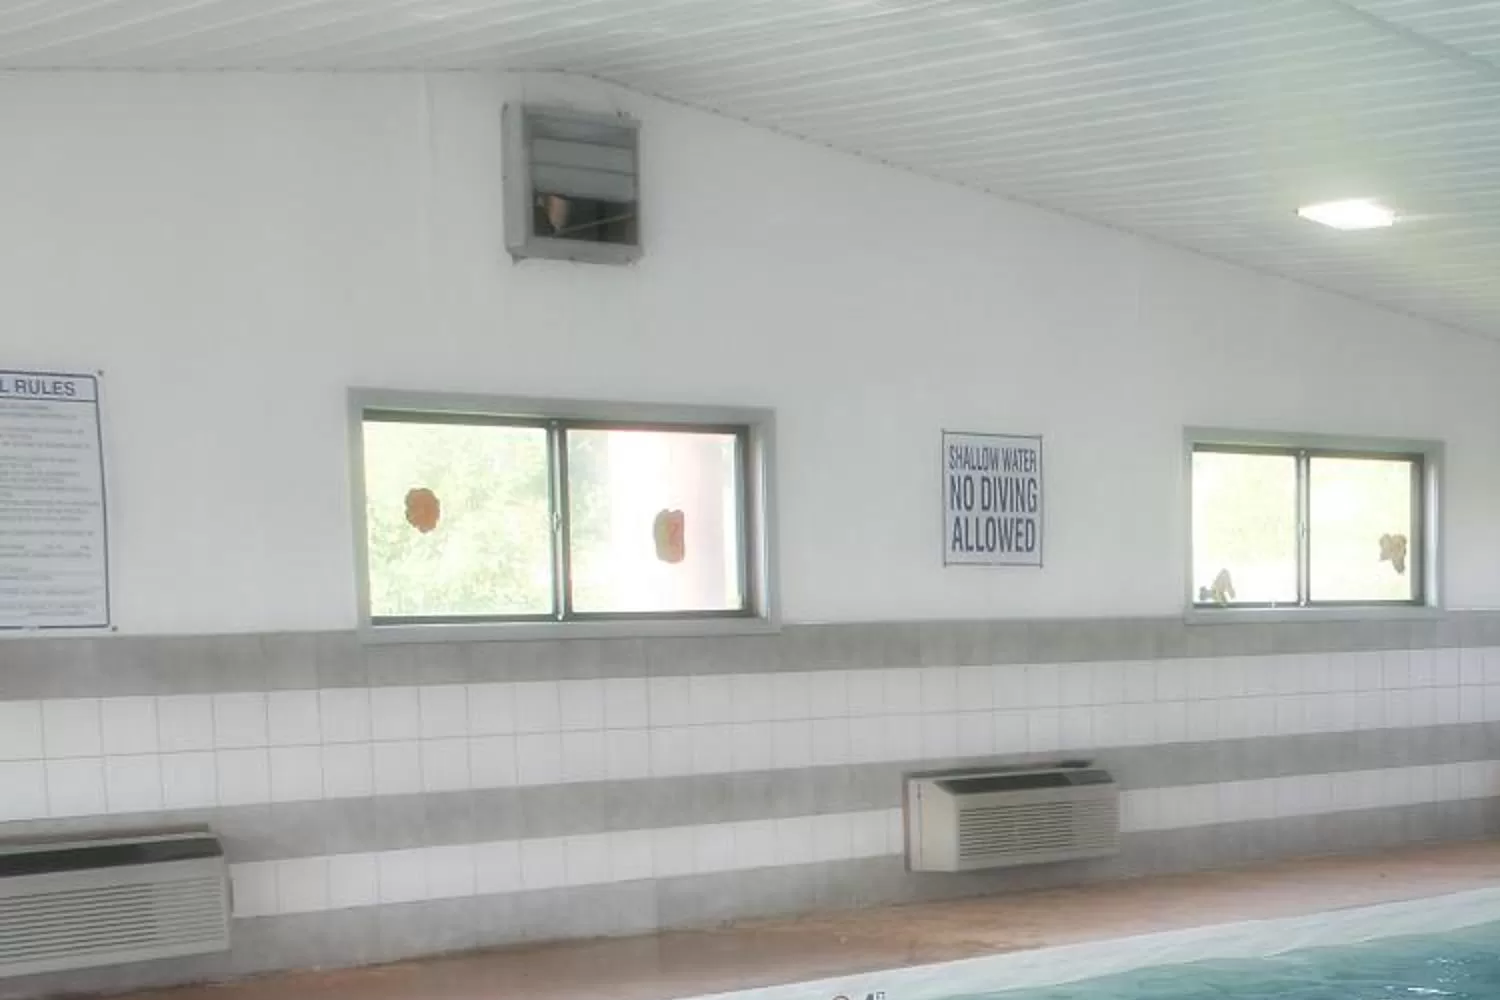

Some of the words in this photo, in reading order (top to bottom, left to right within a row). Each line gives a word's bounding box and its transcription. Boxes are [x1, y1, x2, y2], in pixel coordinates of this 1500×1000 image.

[15, 379, 76, 396] RULES
[949, 444, 999, 472] SHALLOW
[1002, 447, 1037, 473] WATER
[950, 475, 974, 512] NO
[981, 476, 1038, 513] DIVING
[951, 516, 1036, 552] ALLOWED
